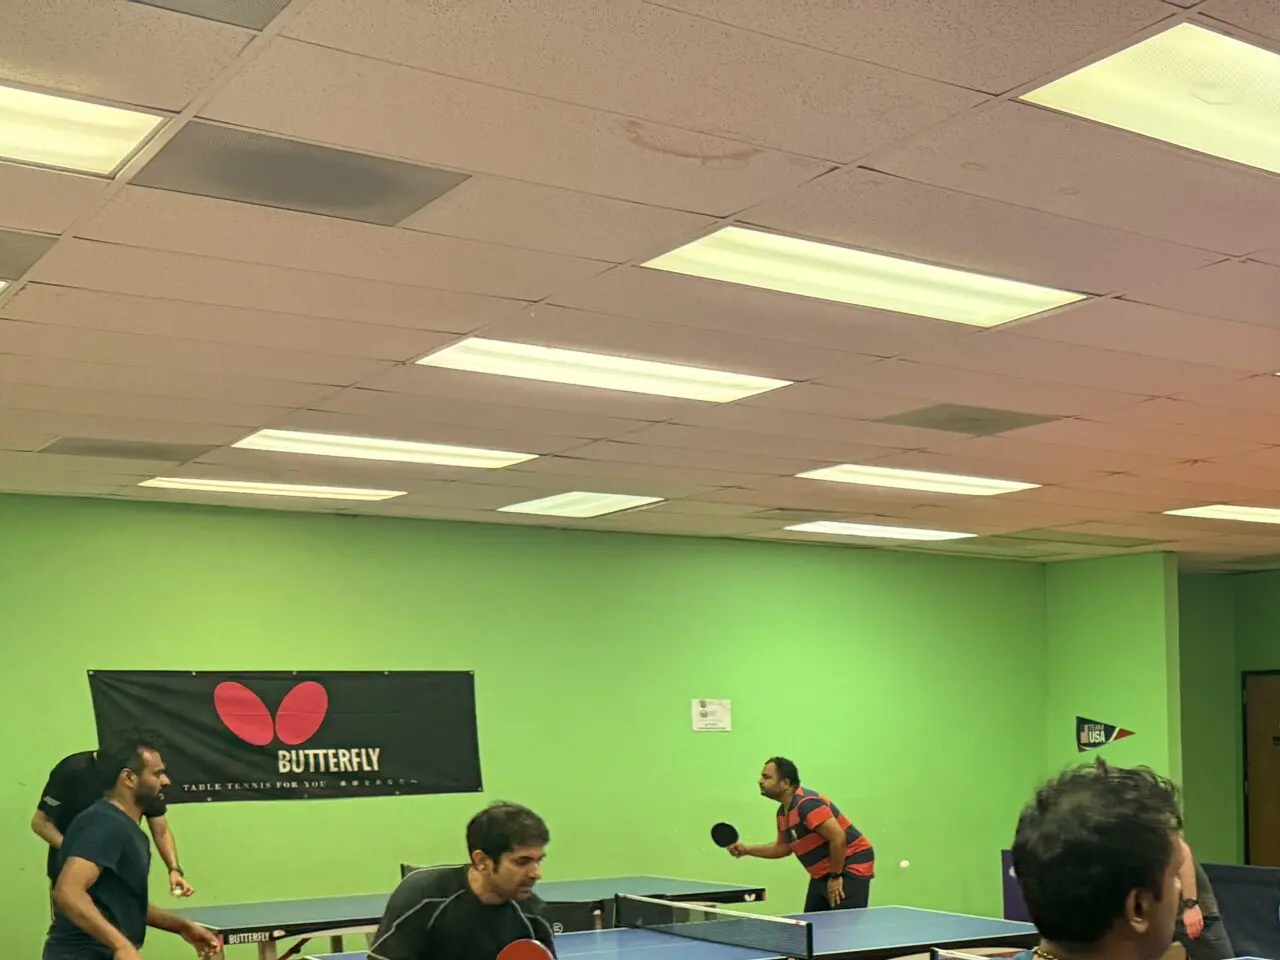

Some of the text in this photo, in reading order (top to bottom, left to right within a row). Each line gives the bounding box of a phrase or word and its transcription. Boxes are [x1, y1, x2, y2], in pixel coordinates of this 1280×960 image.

[1089, 730, 1106, 744] USA
[278, 748, 381, 774] BUTTERFLY
[182, 779, 328, 792] TABLE TENNIS FOR YOU
[228, 931, 270, 944] BUTTERFLY
